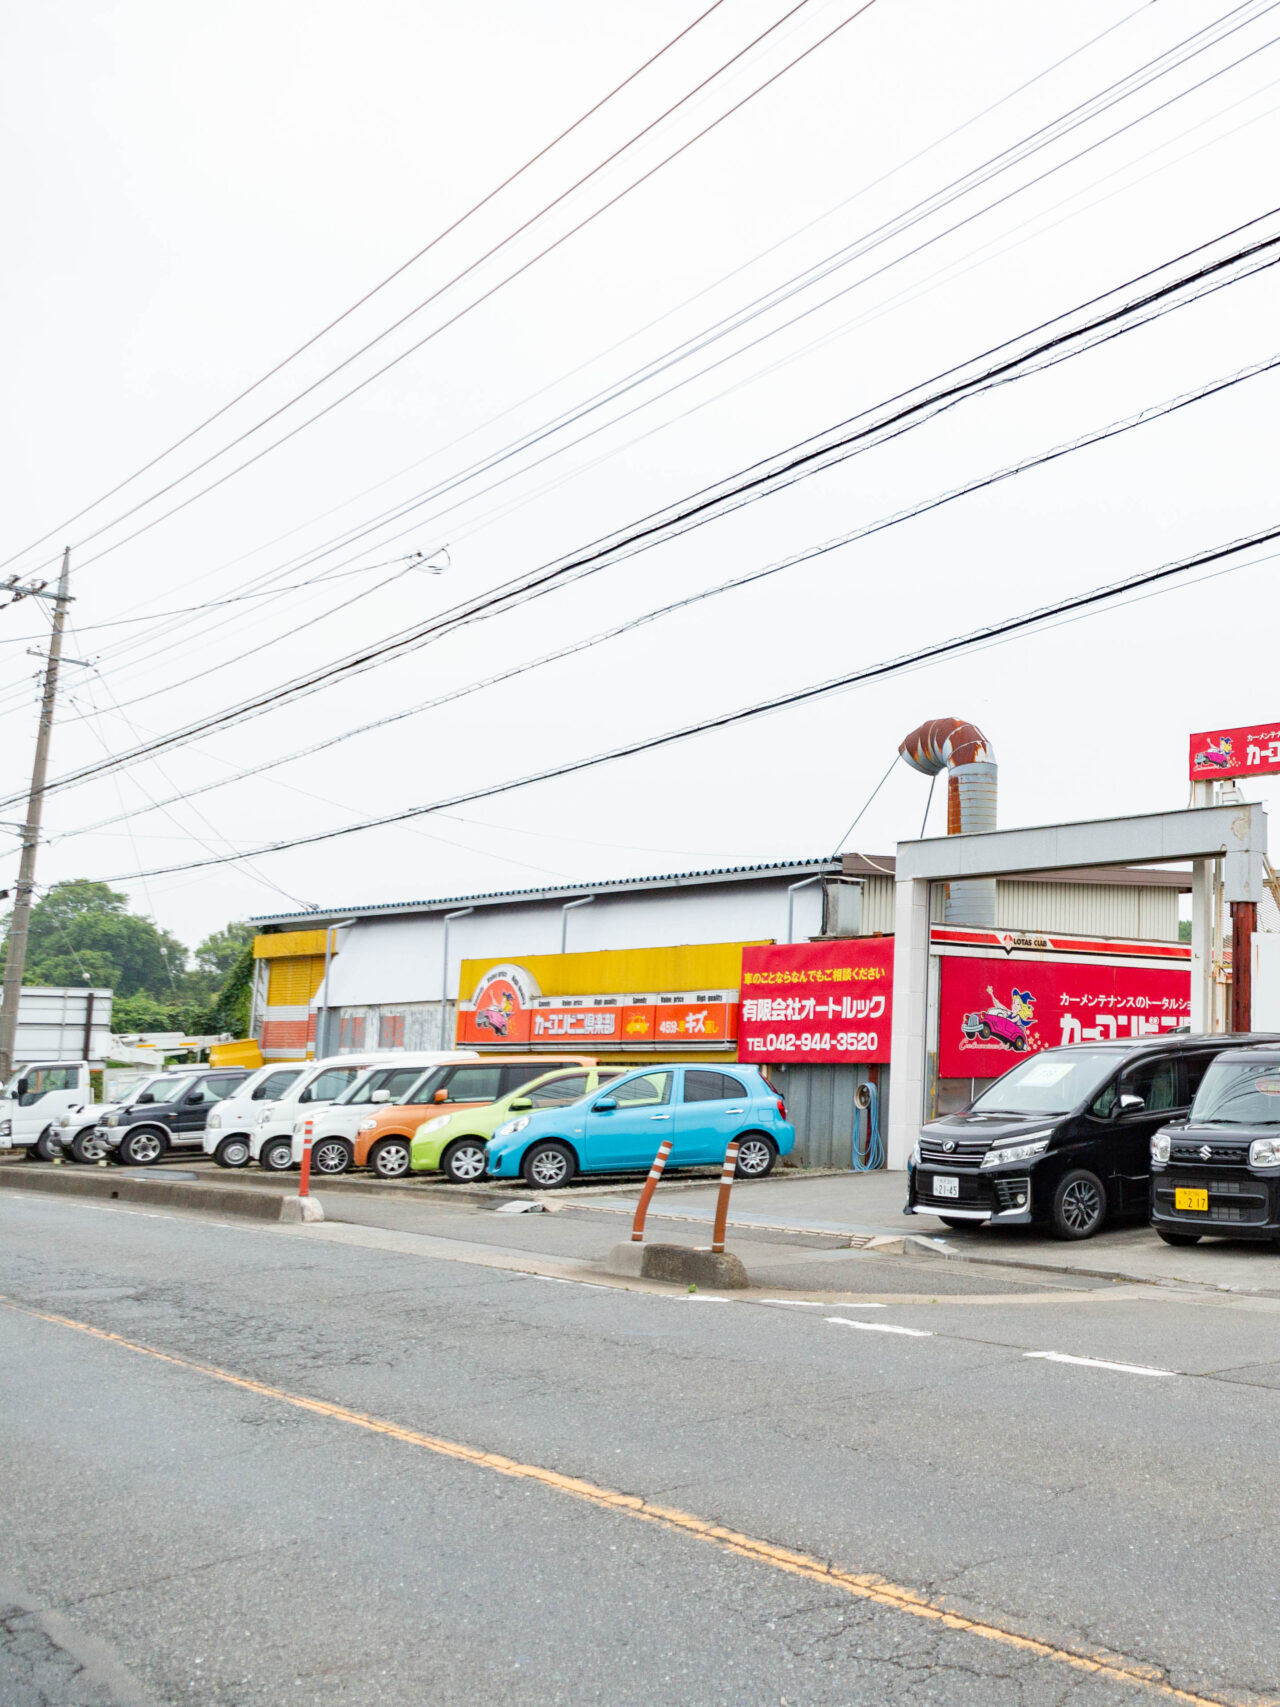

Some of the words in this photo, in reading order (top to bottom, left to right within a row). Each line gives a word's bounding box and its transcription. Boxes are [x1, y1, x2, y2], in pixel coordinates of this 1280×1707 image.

[1013, 938, 1032, 947] LOTAS
[1033, 939, 1047, 947] CLUB
[743, 967, 886, 985] 車のことならなんでもご相談ください
[742, 996, 886, 1022] 有限会社オートルック
[534, 1013, 616, 1036] カーコンビニ倶楽部
